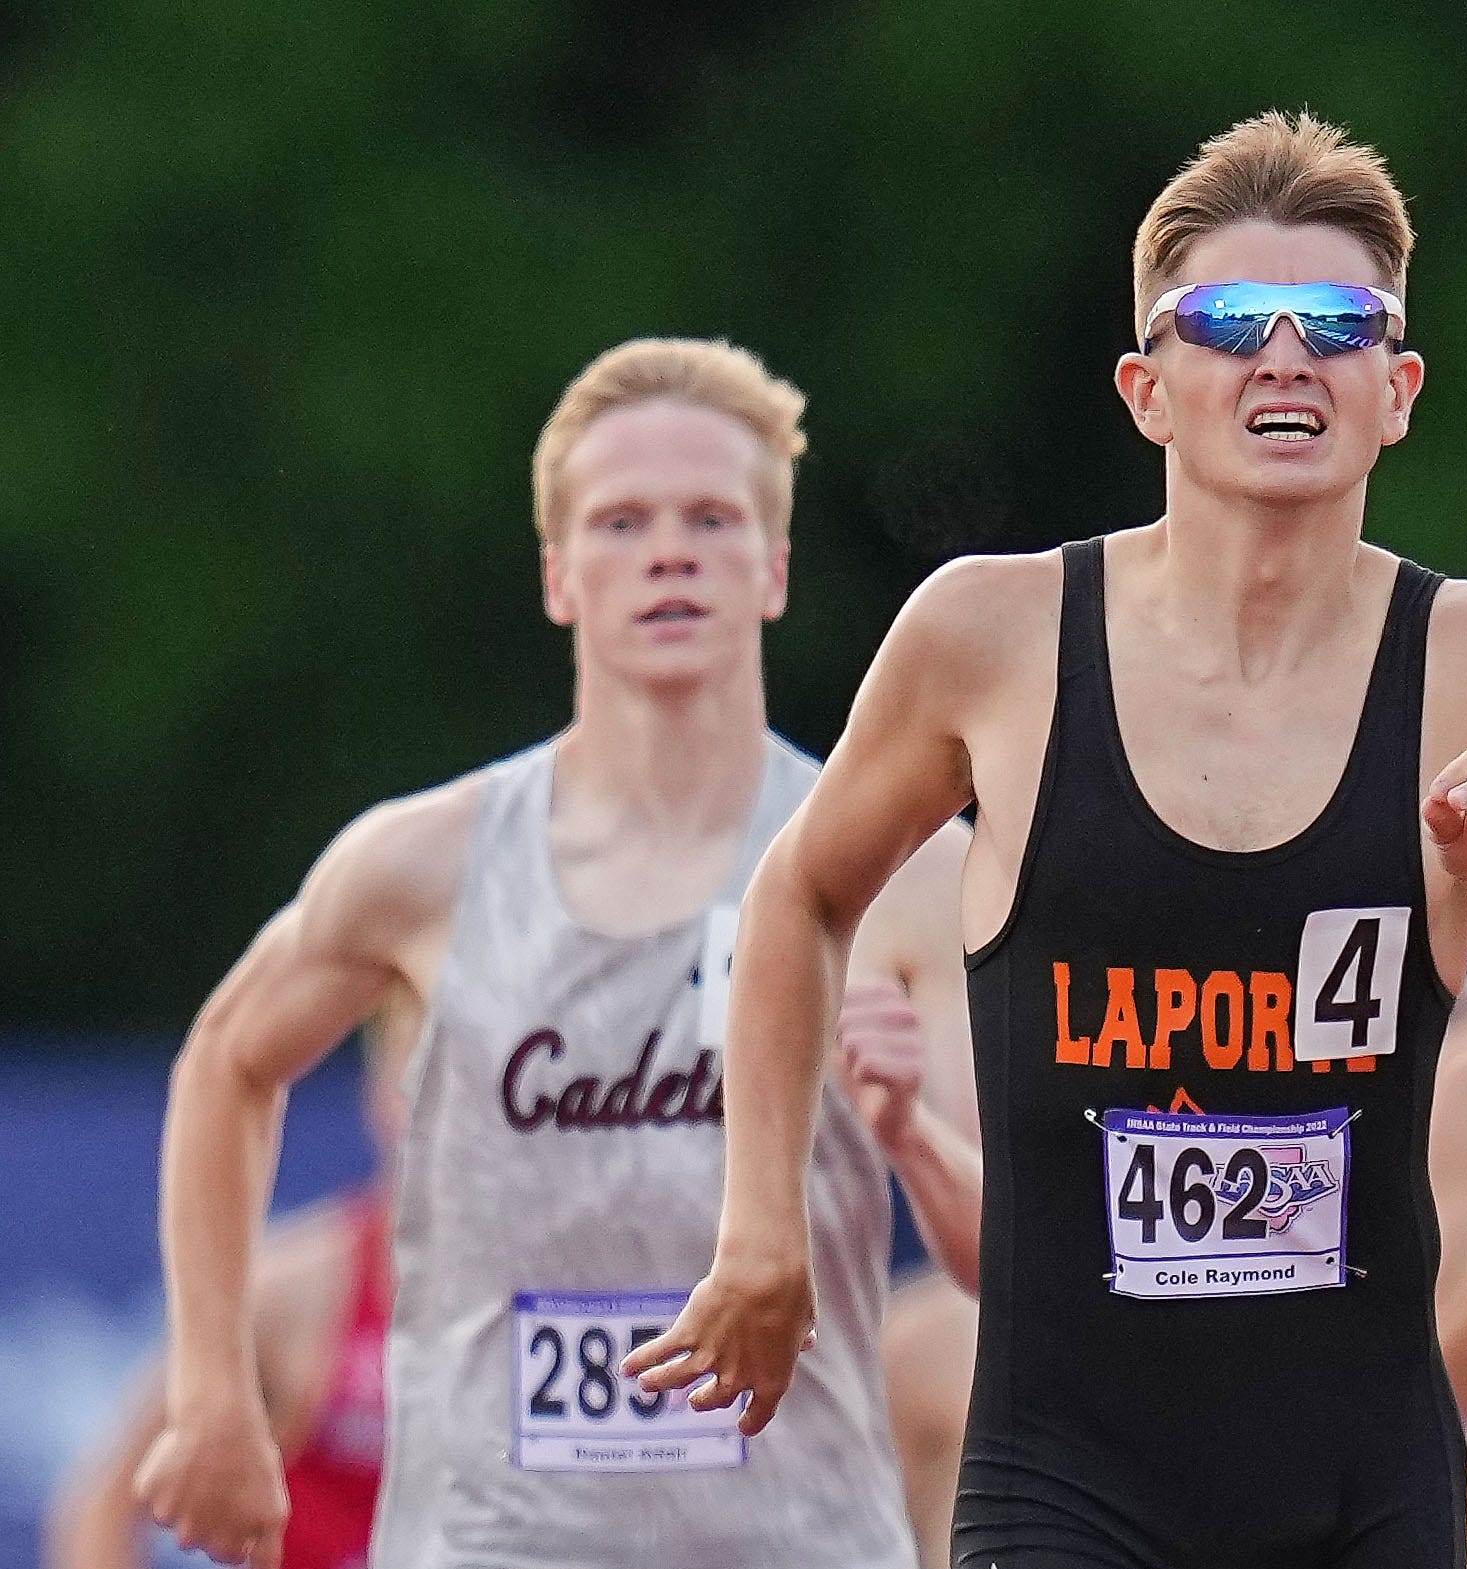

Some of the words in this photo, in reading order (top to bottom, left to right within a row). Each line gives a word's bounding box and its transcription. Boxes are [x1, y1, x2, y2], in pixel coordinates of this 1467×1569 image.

[1053, 961, 1377, 1073] LAPOR
[1314, 917, 1382, 1049] 4
[1182, 1121, 1207, 1134] Track
[1118, 1144, 1268, 1243] 462
[1155, 1270, 1199, 1286] Cole
[1205, 1264, 1296, 1286] Raymond
